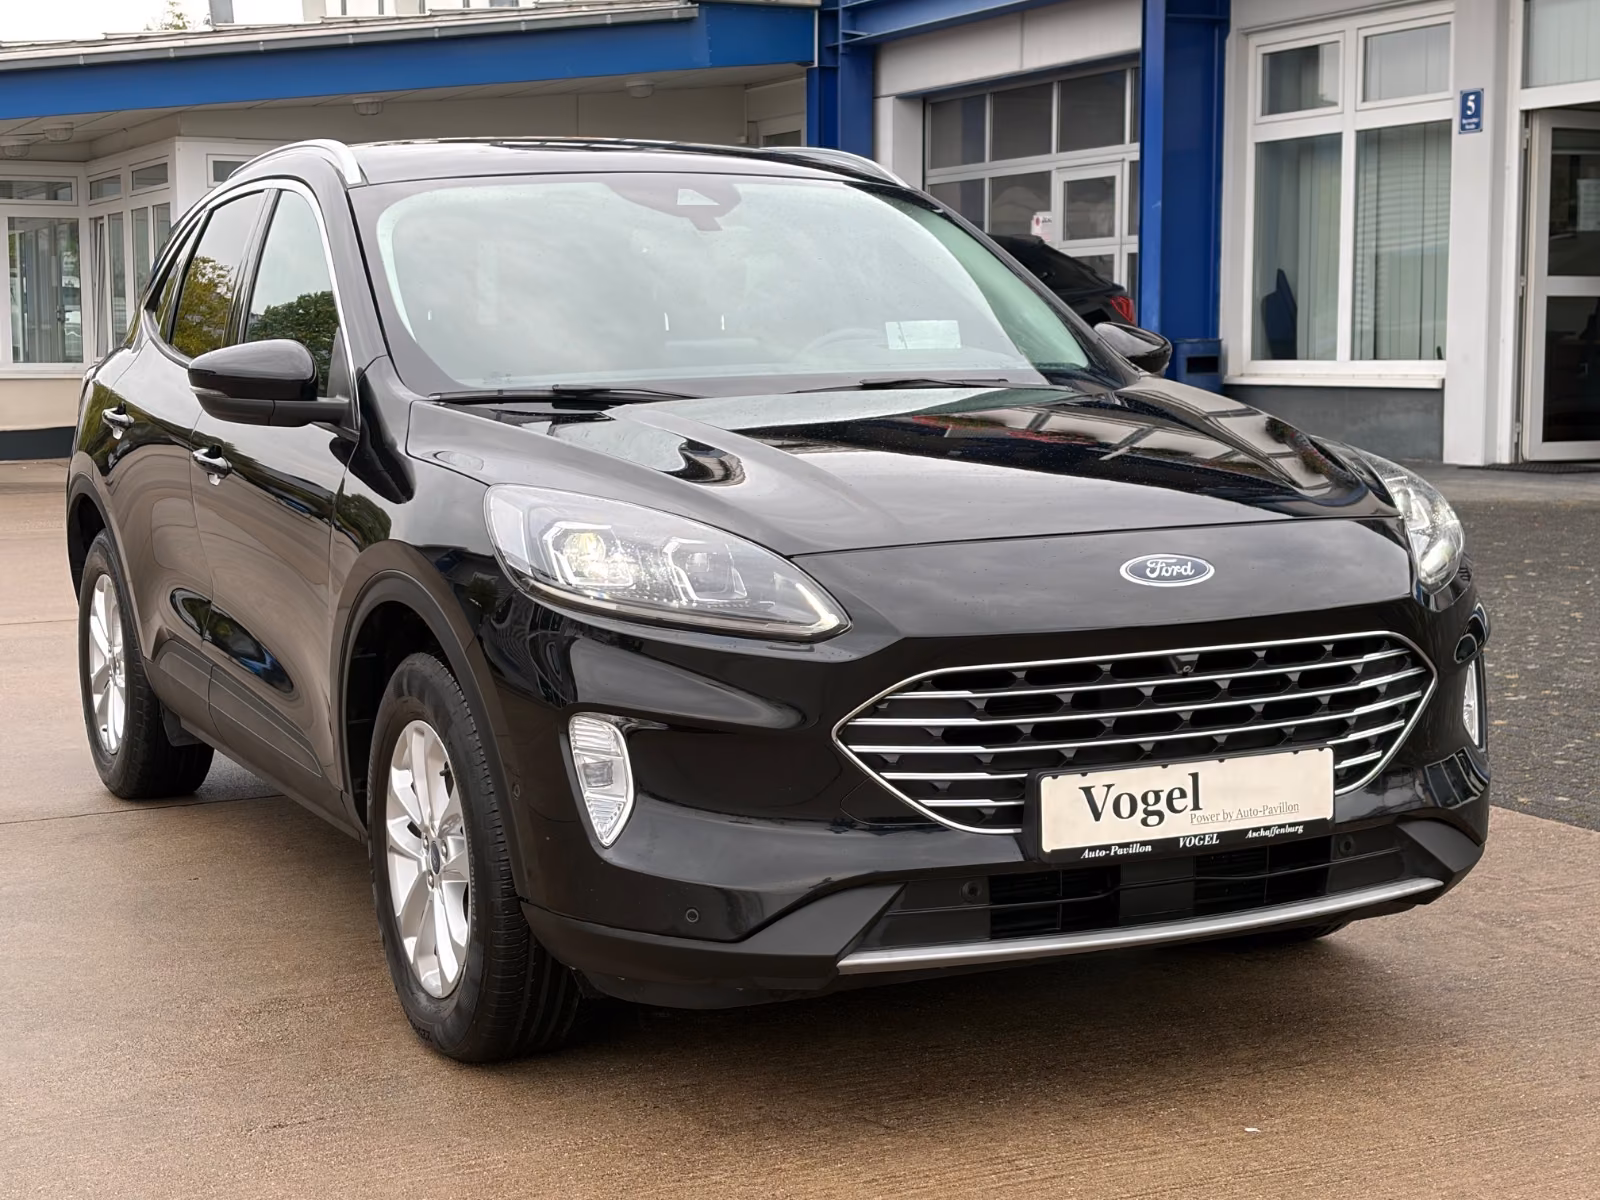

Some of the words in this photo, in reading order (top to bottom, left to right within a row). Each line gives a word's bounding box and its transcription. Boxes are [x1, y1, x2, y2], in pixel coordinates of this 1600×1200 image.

[1466, 94, 1476, 115] 5
[1146, 559, 1195, 578] Ford
[1078, 772, 1203, 827] Vogel
[1190, 813, 1221, 824] Power
[1222, 809, 1235, 822] by
[1236, 801, 1300, 819] Auto-Pavillon
[1081, 843, 1152, 859] Auto-Pavillon
[1179, 833, 1220, 848] VOGEL
[1245, 824, 1304, 838] Aschaffenburg
